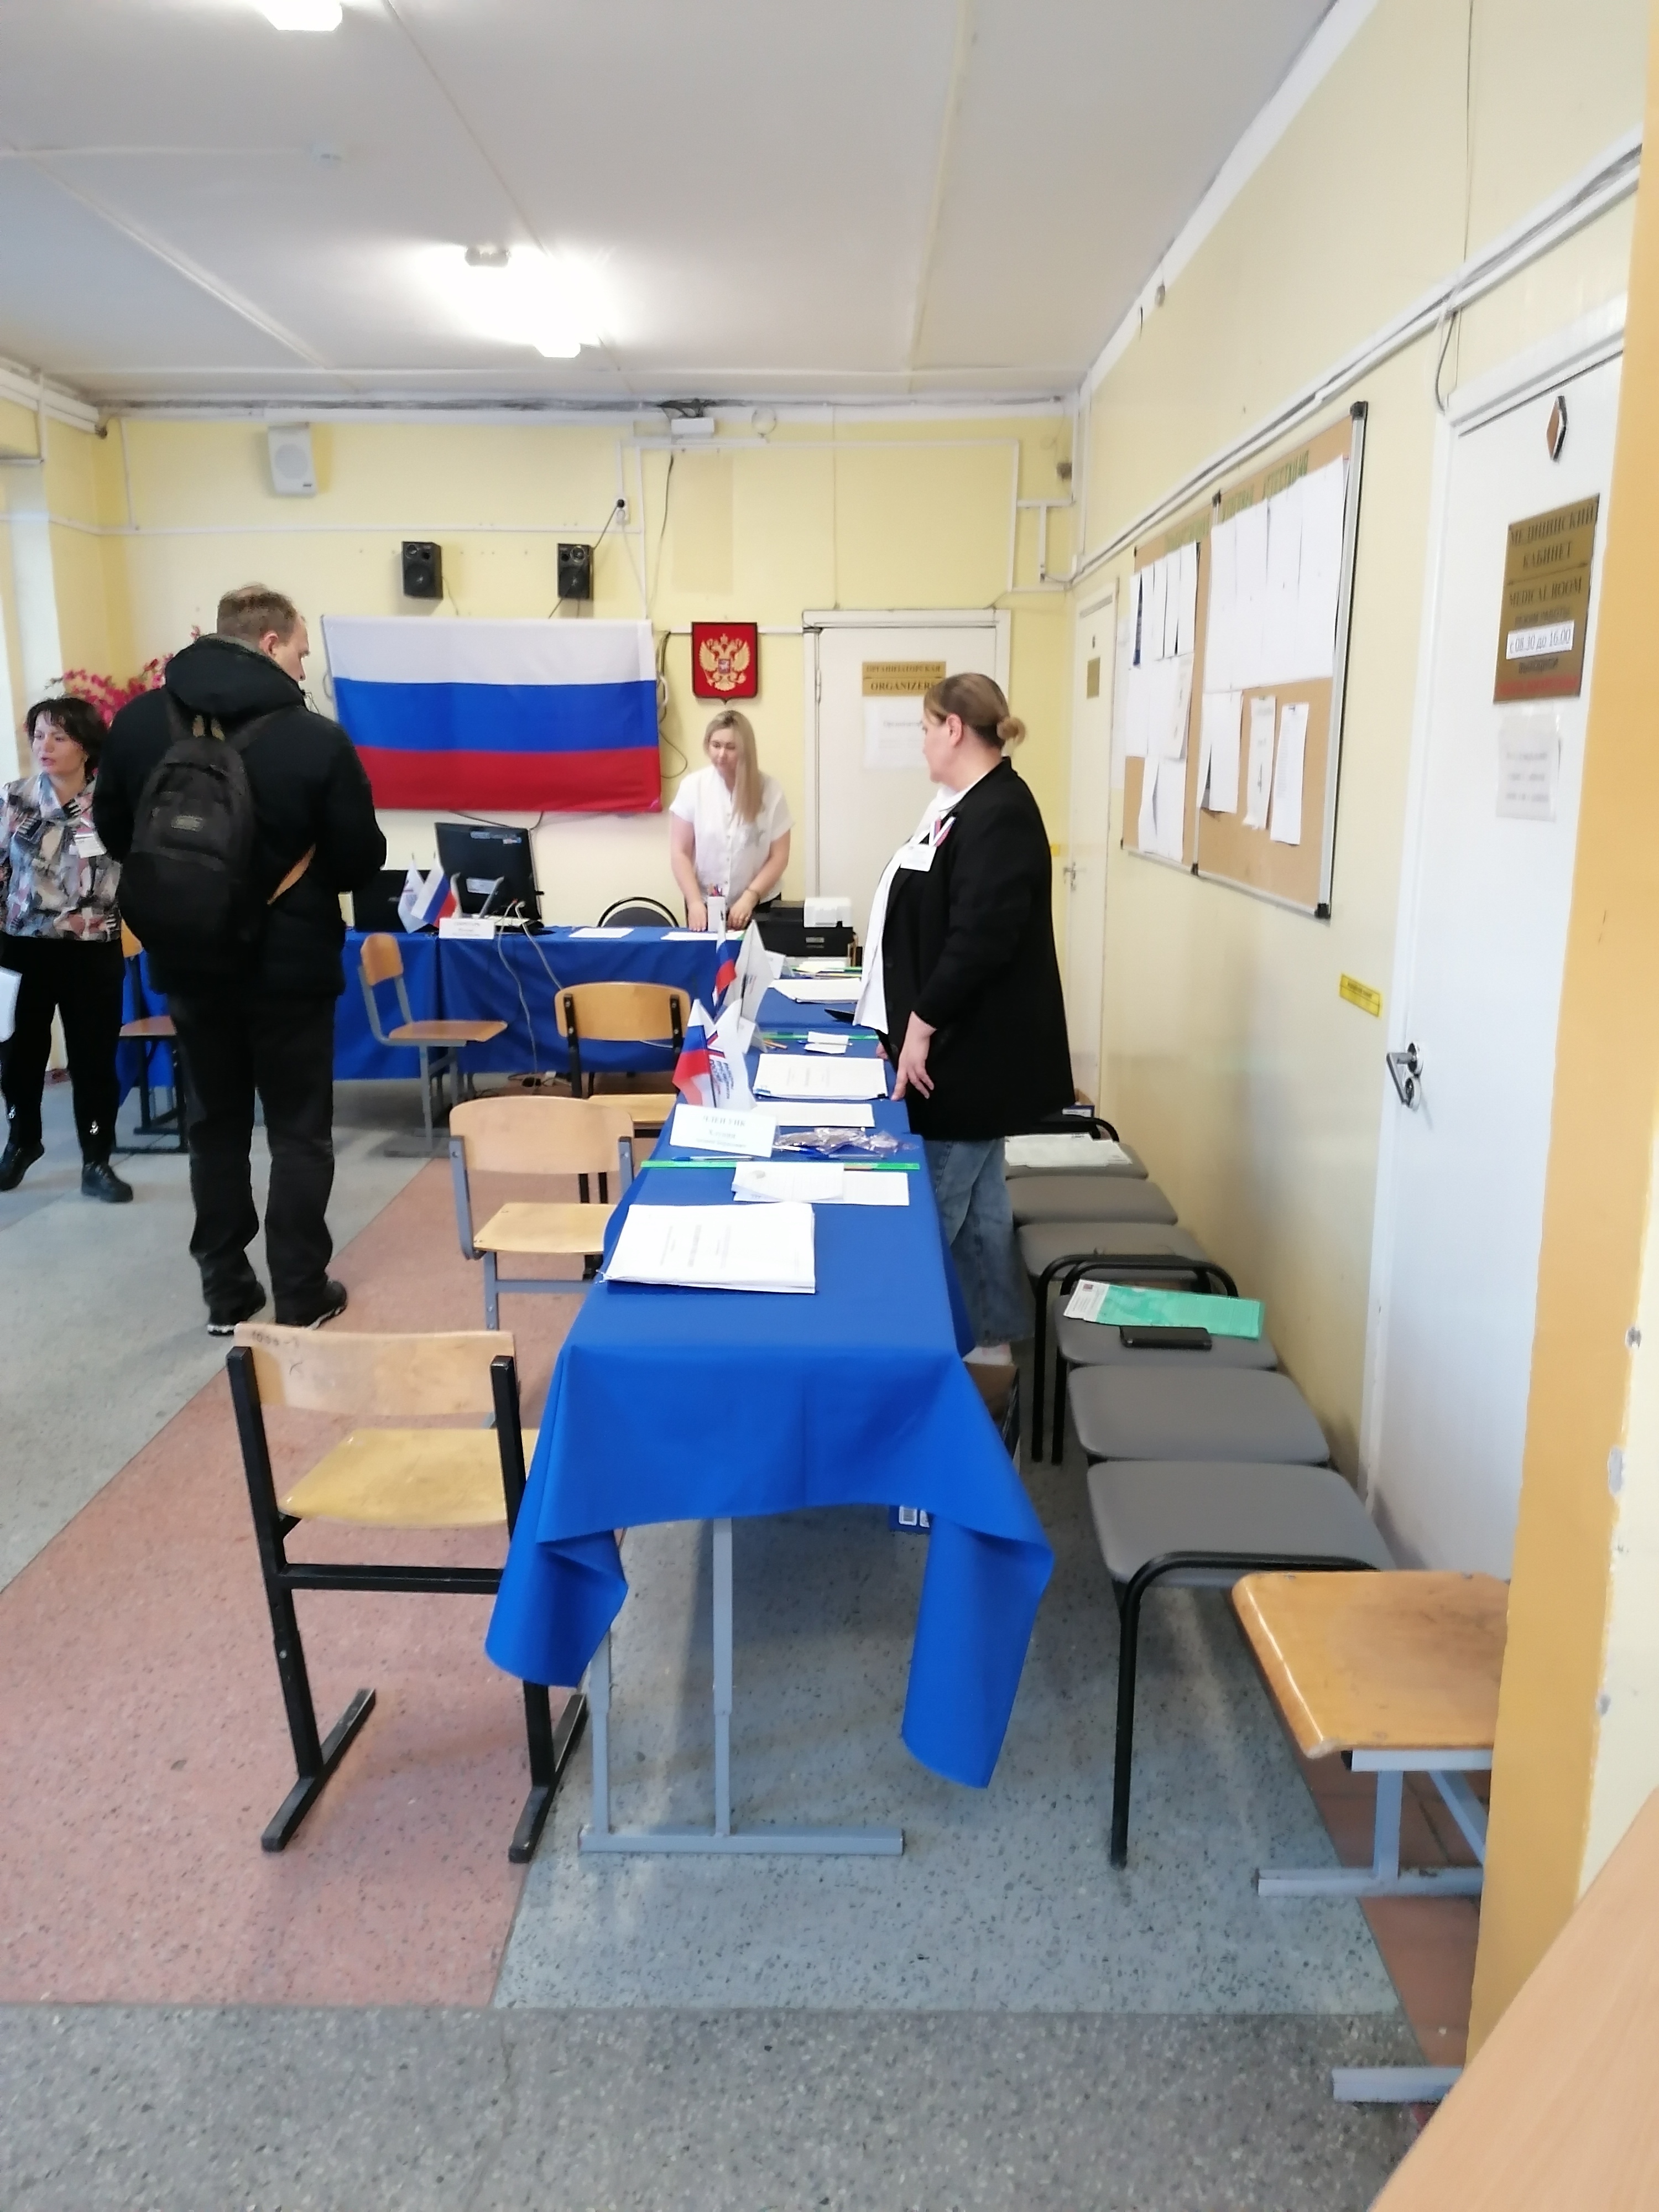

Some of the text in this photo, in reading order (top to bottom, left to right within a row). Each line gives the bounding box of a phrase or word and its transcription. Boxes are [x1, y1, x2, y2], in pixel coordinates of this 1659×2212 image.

[1510, 503, 1594, 546] МЕДИЦИНСКИЙ
[1523, 541, 1571, 570] КАБИНЕТ
[1551, 576, 1582, 599] ROOM
